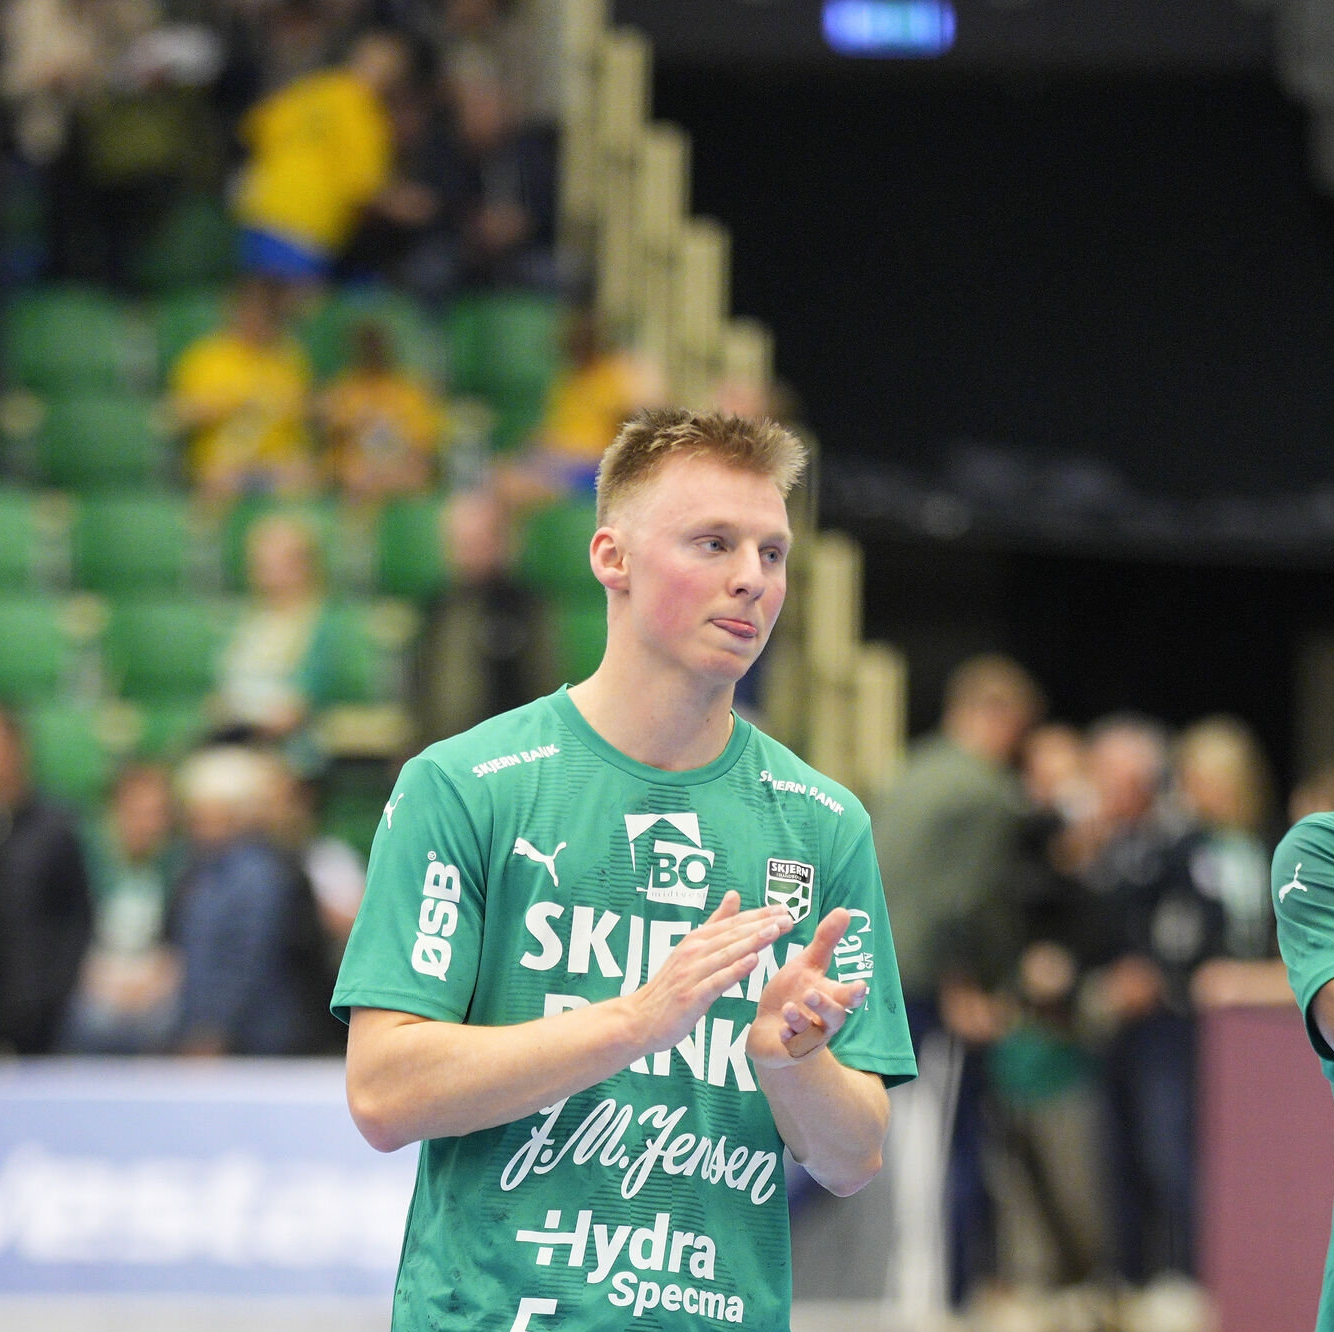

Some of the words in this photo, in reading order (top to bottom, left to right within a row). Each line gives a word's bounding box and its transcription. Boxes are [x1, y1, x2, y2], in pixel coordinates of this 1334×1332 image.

[472, 752, 522, 779] SKJERN
[521, 742, 561, 764] BANK
[758, 770, 807, 794] SJERN
[651, 853, 713, 889] BO
[771, 862, 809, 878] SKJERN
[515, 1209, 717, 1284] Hydra
[608, 1271, 744, 1323] Specma
